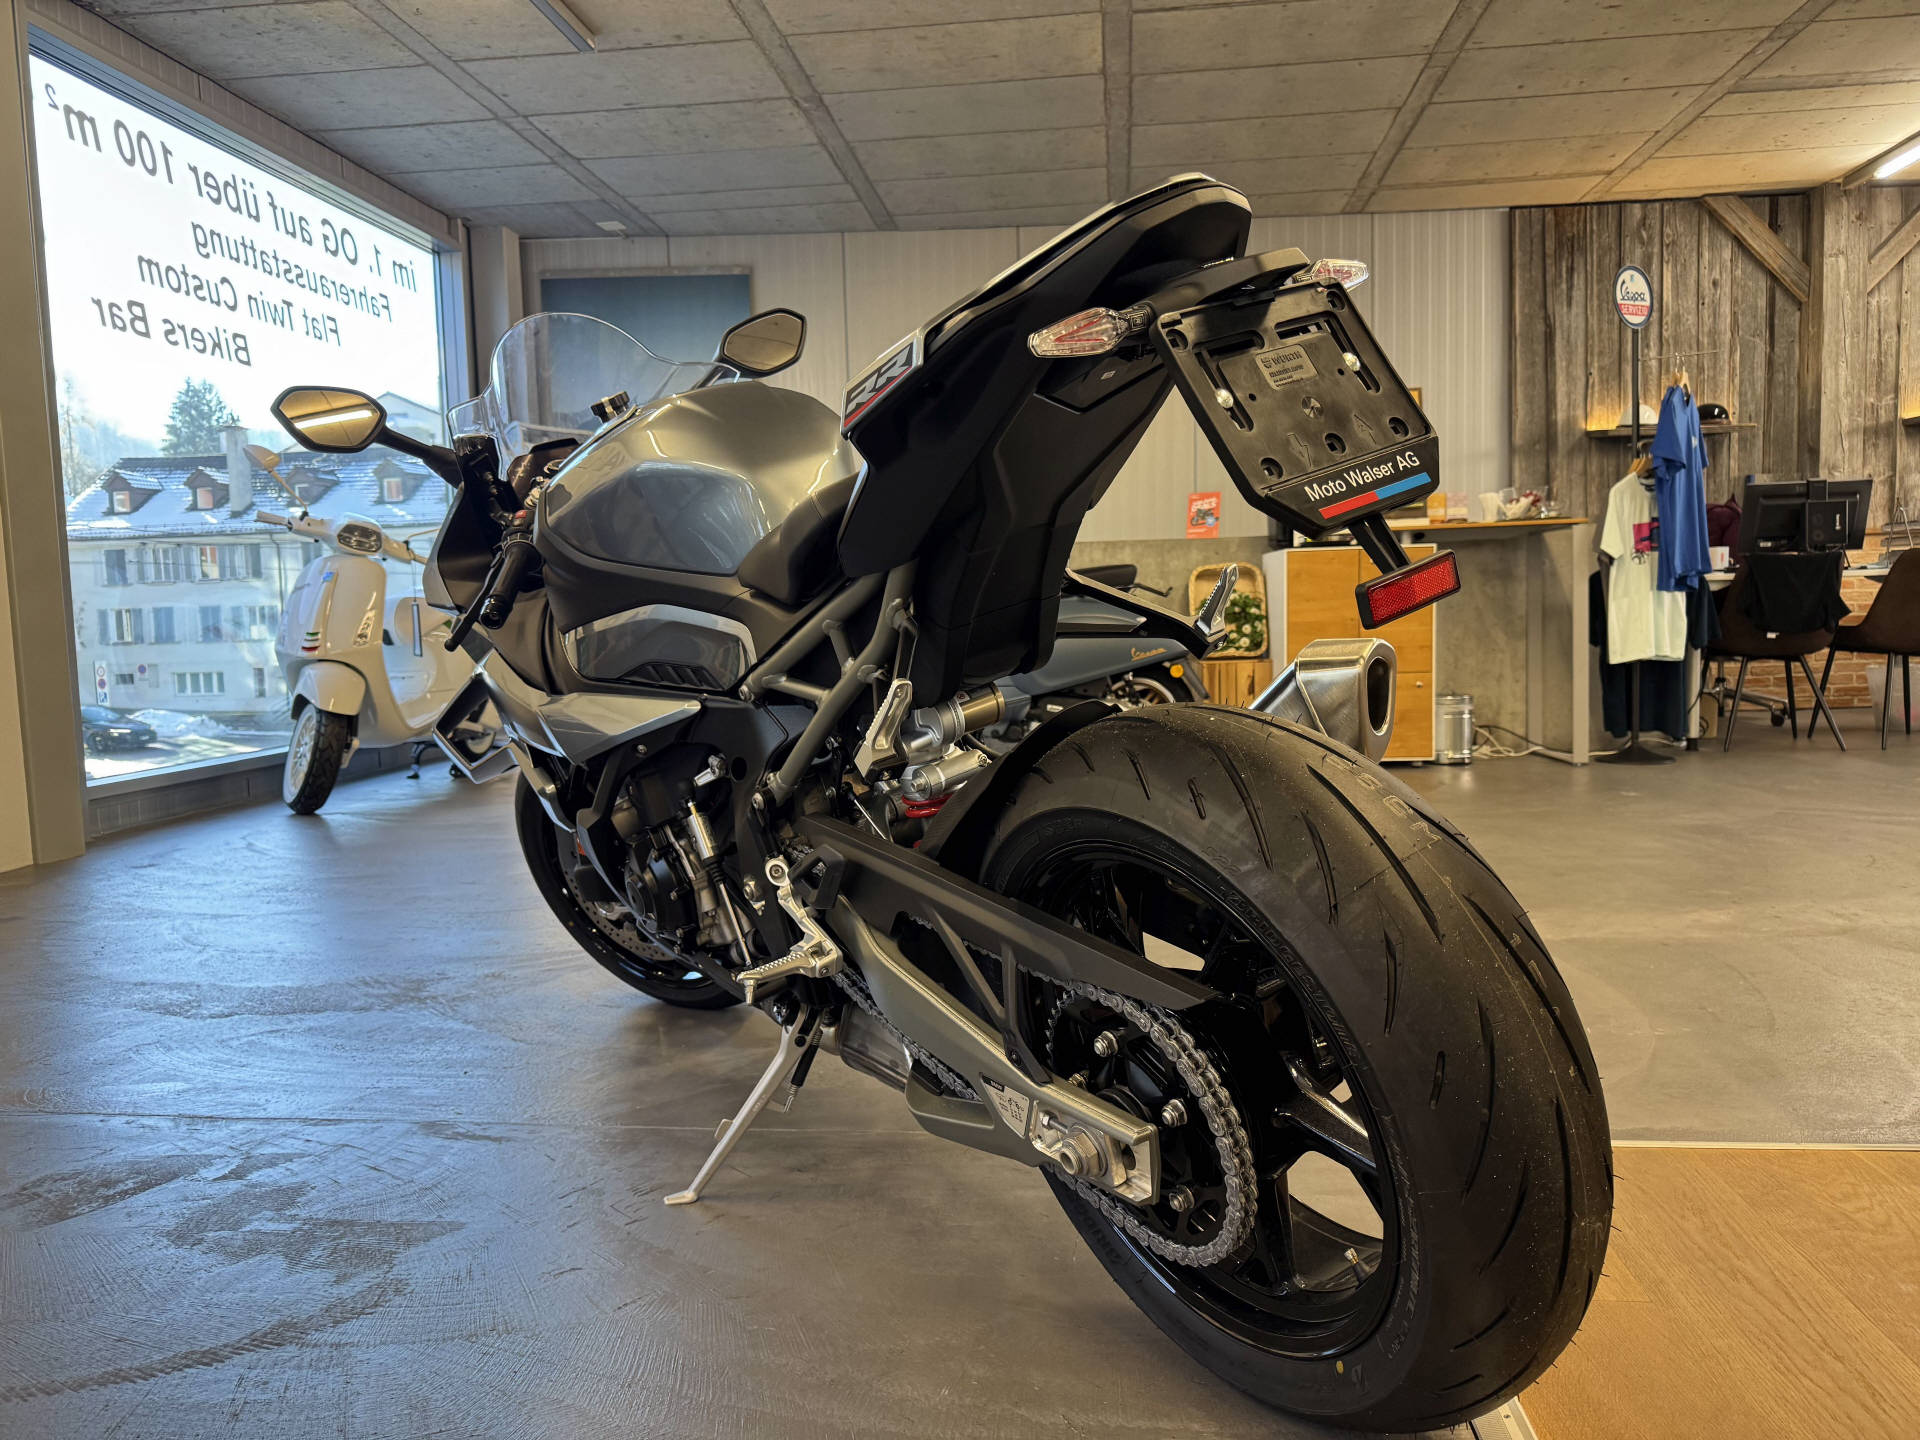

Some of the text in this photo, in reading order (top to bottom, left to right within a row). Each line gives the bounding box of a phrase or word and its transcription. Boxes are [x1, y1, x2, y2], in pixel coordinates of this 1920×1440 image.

[1620, 279, 1646, 302] Vespa
[846, 345, 910, 415] RR
[1303, 451, 1421, 502] Moto Walser AG
